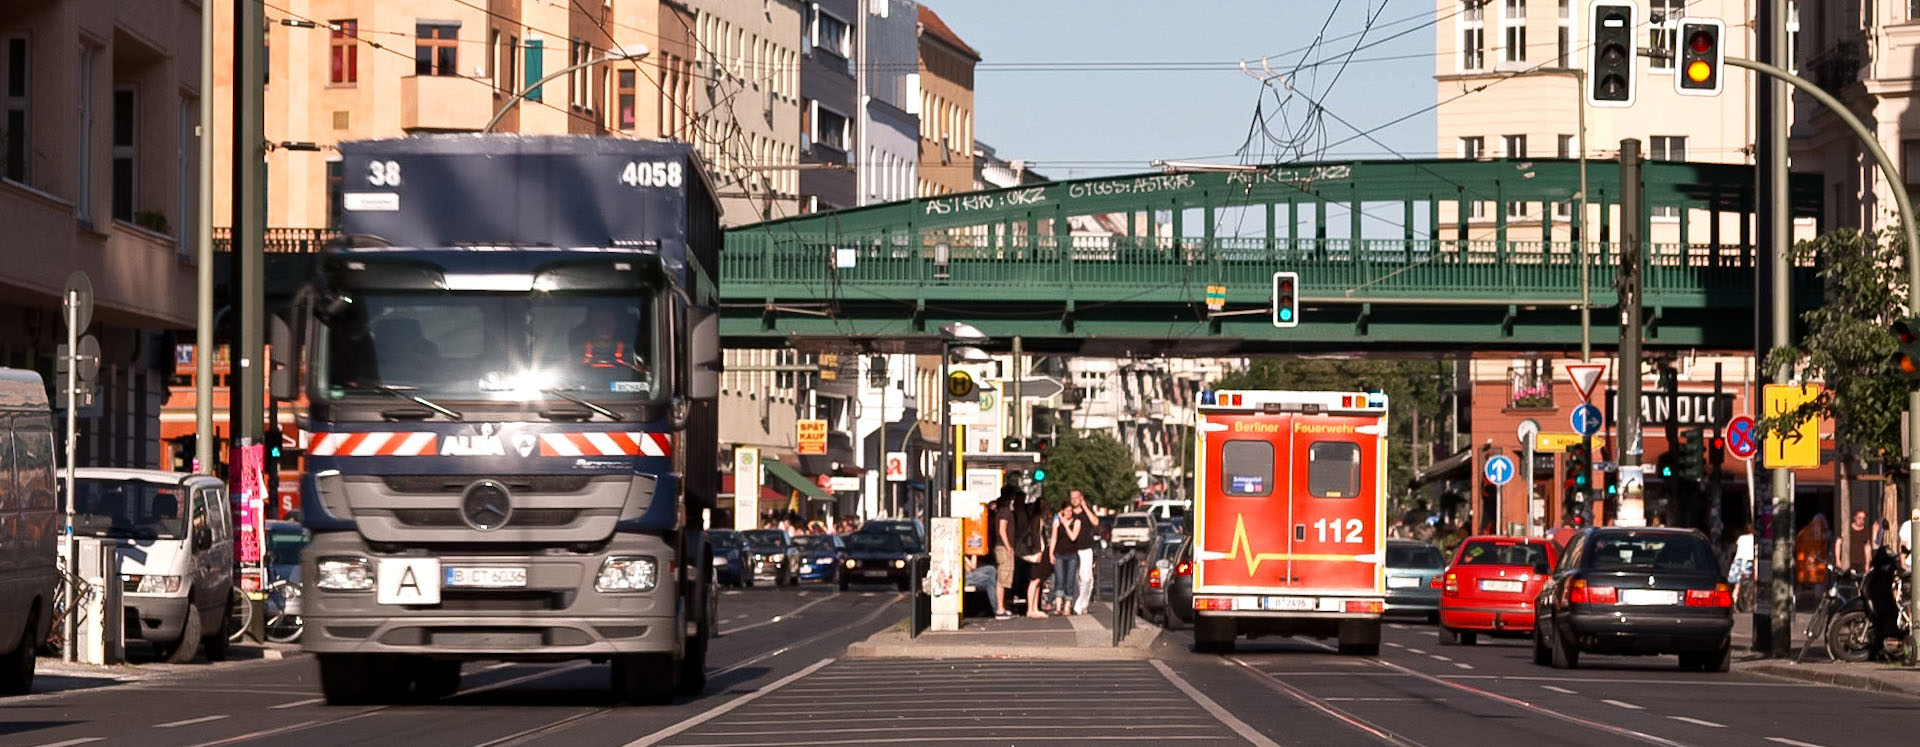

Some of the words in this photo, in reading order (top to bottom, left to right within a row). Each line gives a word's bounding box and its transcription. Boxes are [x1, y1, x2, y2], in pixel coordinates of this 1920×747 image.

[368, 160, 401, 187] 38
[621, 161, 683, 188] 4058
[953, 376, 966, 391] H
[1613, 394, 1716, 423] ANOLO
[800, 422, 825, 431] SPÄT
[1234, 420, 1280, 433] Berliner
[1294, 422, 1356, 434] Feuerwehr
[1313, 518, 1364, 544] 112
[396, 565, 422, 597] A
[453, 570, 465, 583] B
